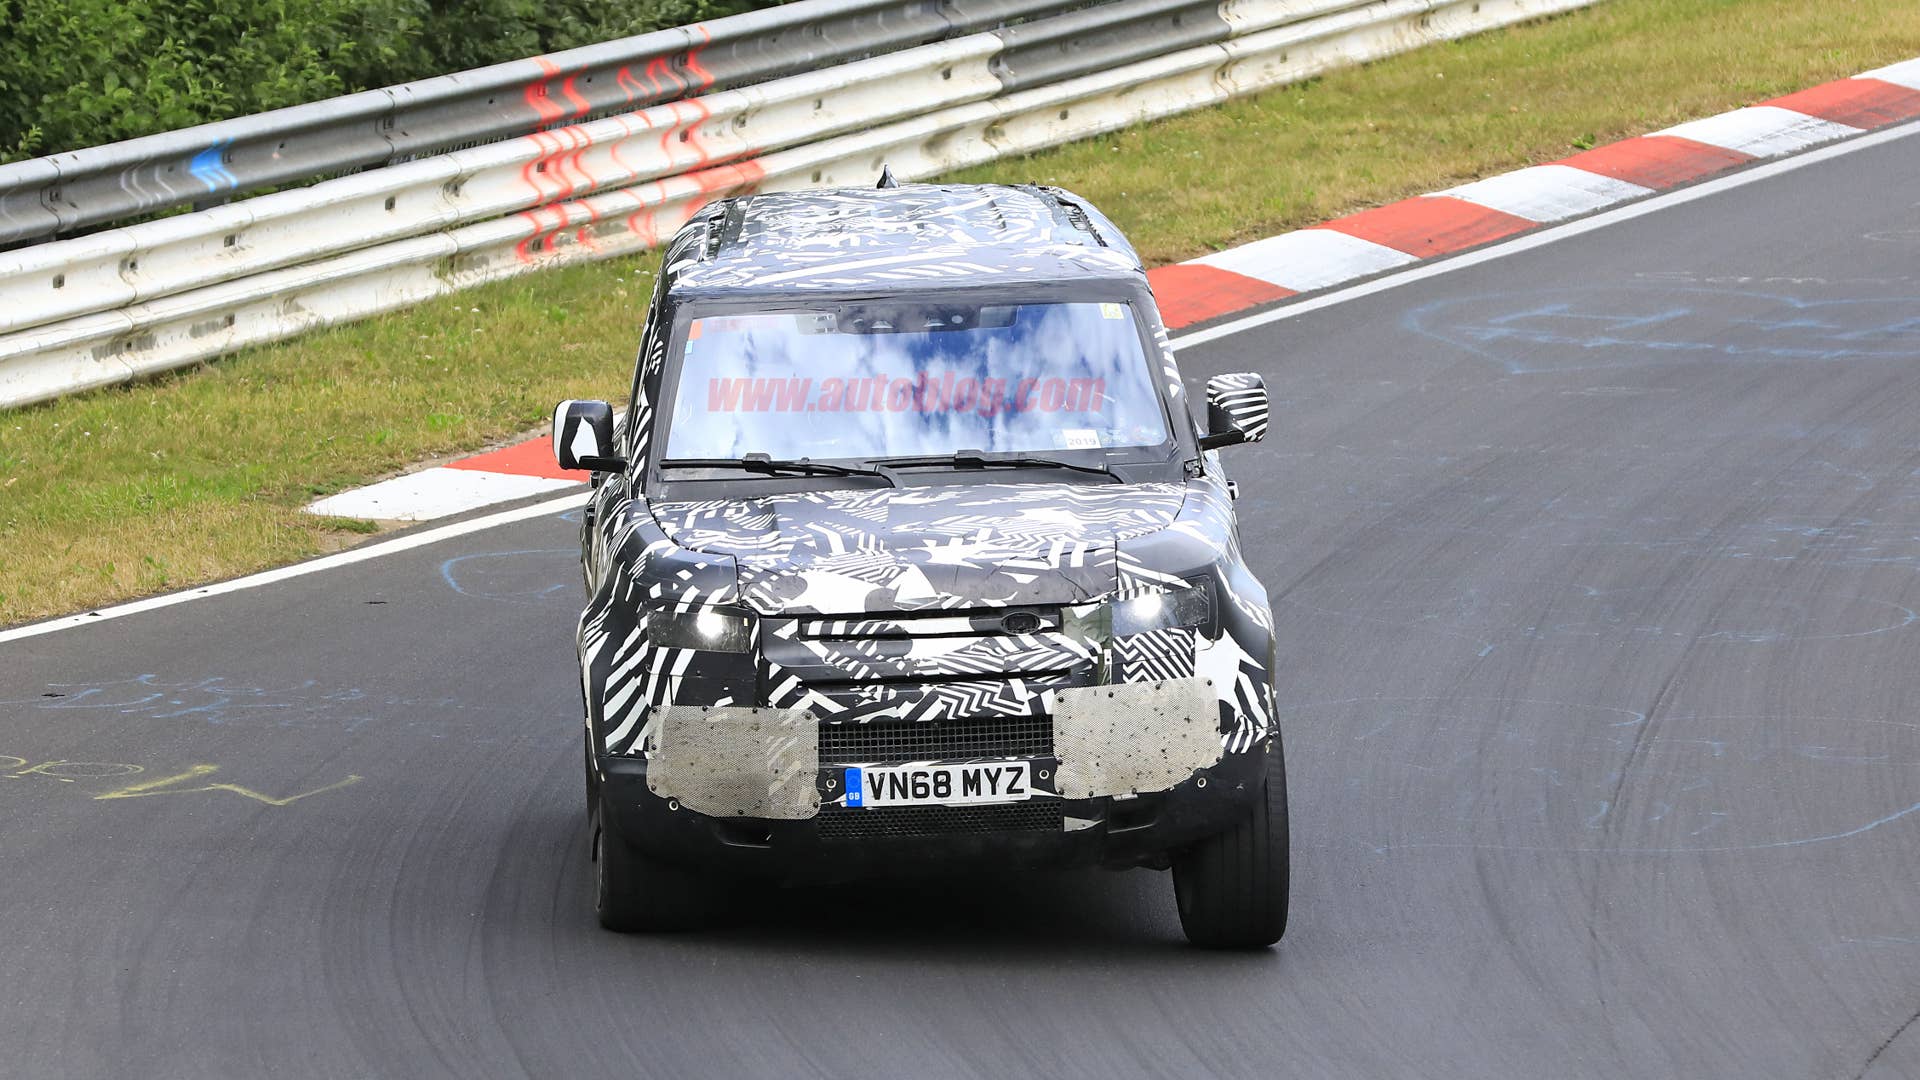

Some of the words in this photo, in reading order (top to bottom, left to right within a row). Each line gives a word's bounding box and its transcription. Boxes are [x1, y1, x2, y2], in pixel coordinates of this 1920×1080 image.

[1069, 438, 1097, 446] 2019
[868, 770, 952, 800] VN68
[962, 766, 1025, 797] MYZ
[848, 792, 860, 800] GB
